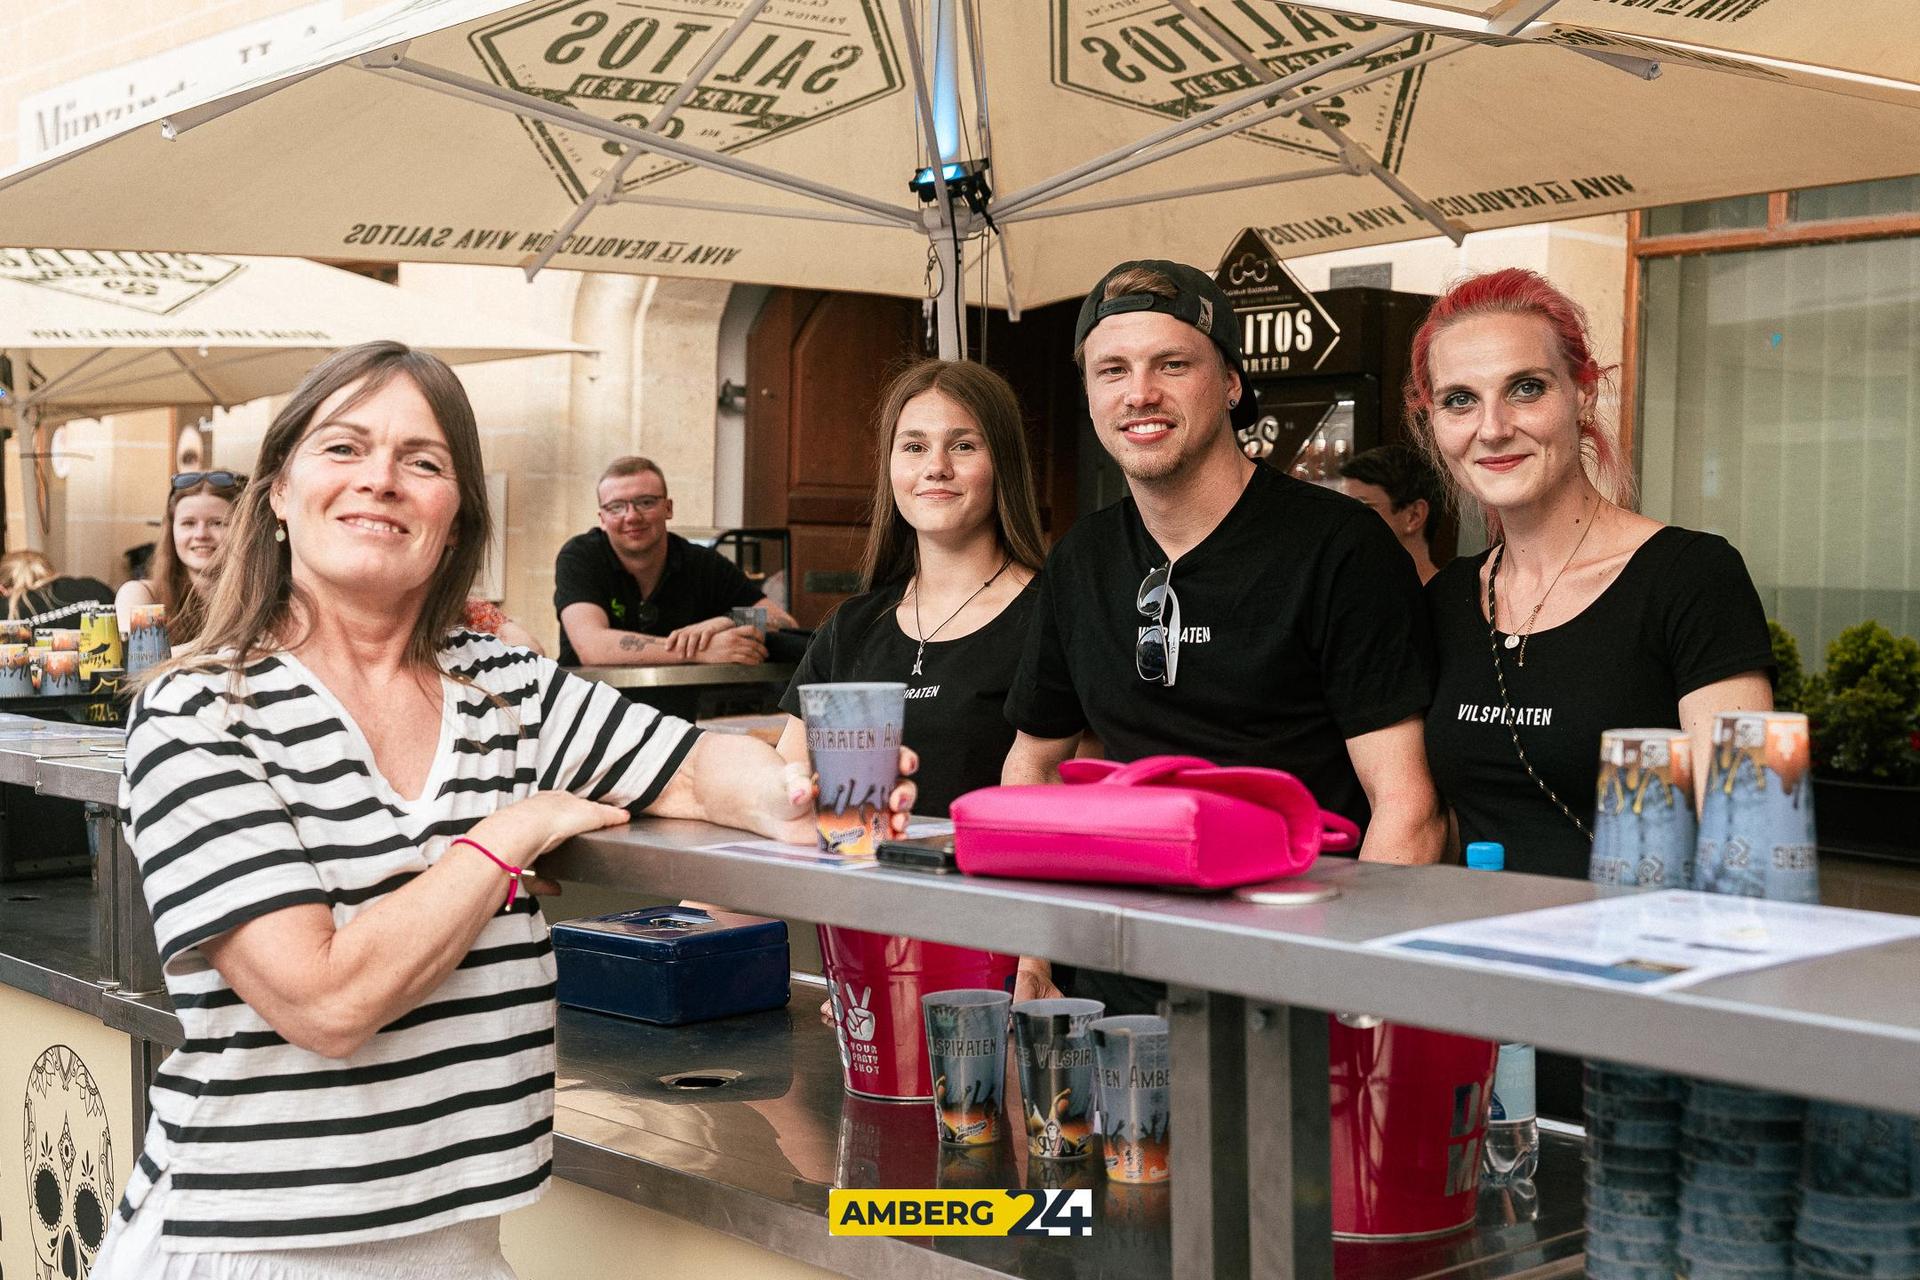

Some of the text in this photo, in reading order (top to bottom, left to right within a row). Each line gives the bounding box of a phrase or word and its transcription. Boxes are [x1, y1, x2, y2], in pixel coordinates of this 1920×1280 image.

[1244, 308, 1313, 356] ITOS
[1243, 355, 1290, 373] ORTED
[904, 685, 940, 699] IRATEN
[808, 727, 876, 750] SPIRATEN
[851, 1042, 877, 1055] YOUR
[935, 1039, 998, 1057] SPIRATEN
[1033, 1042, 1094, 1070] VILSPIR
[854, 1063, 880, 1075] SHOT
